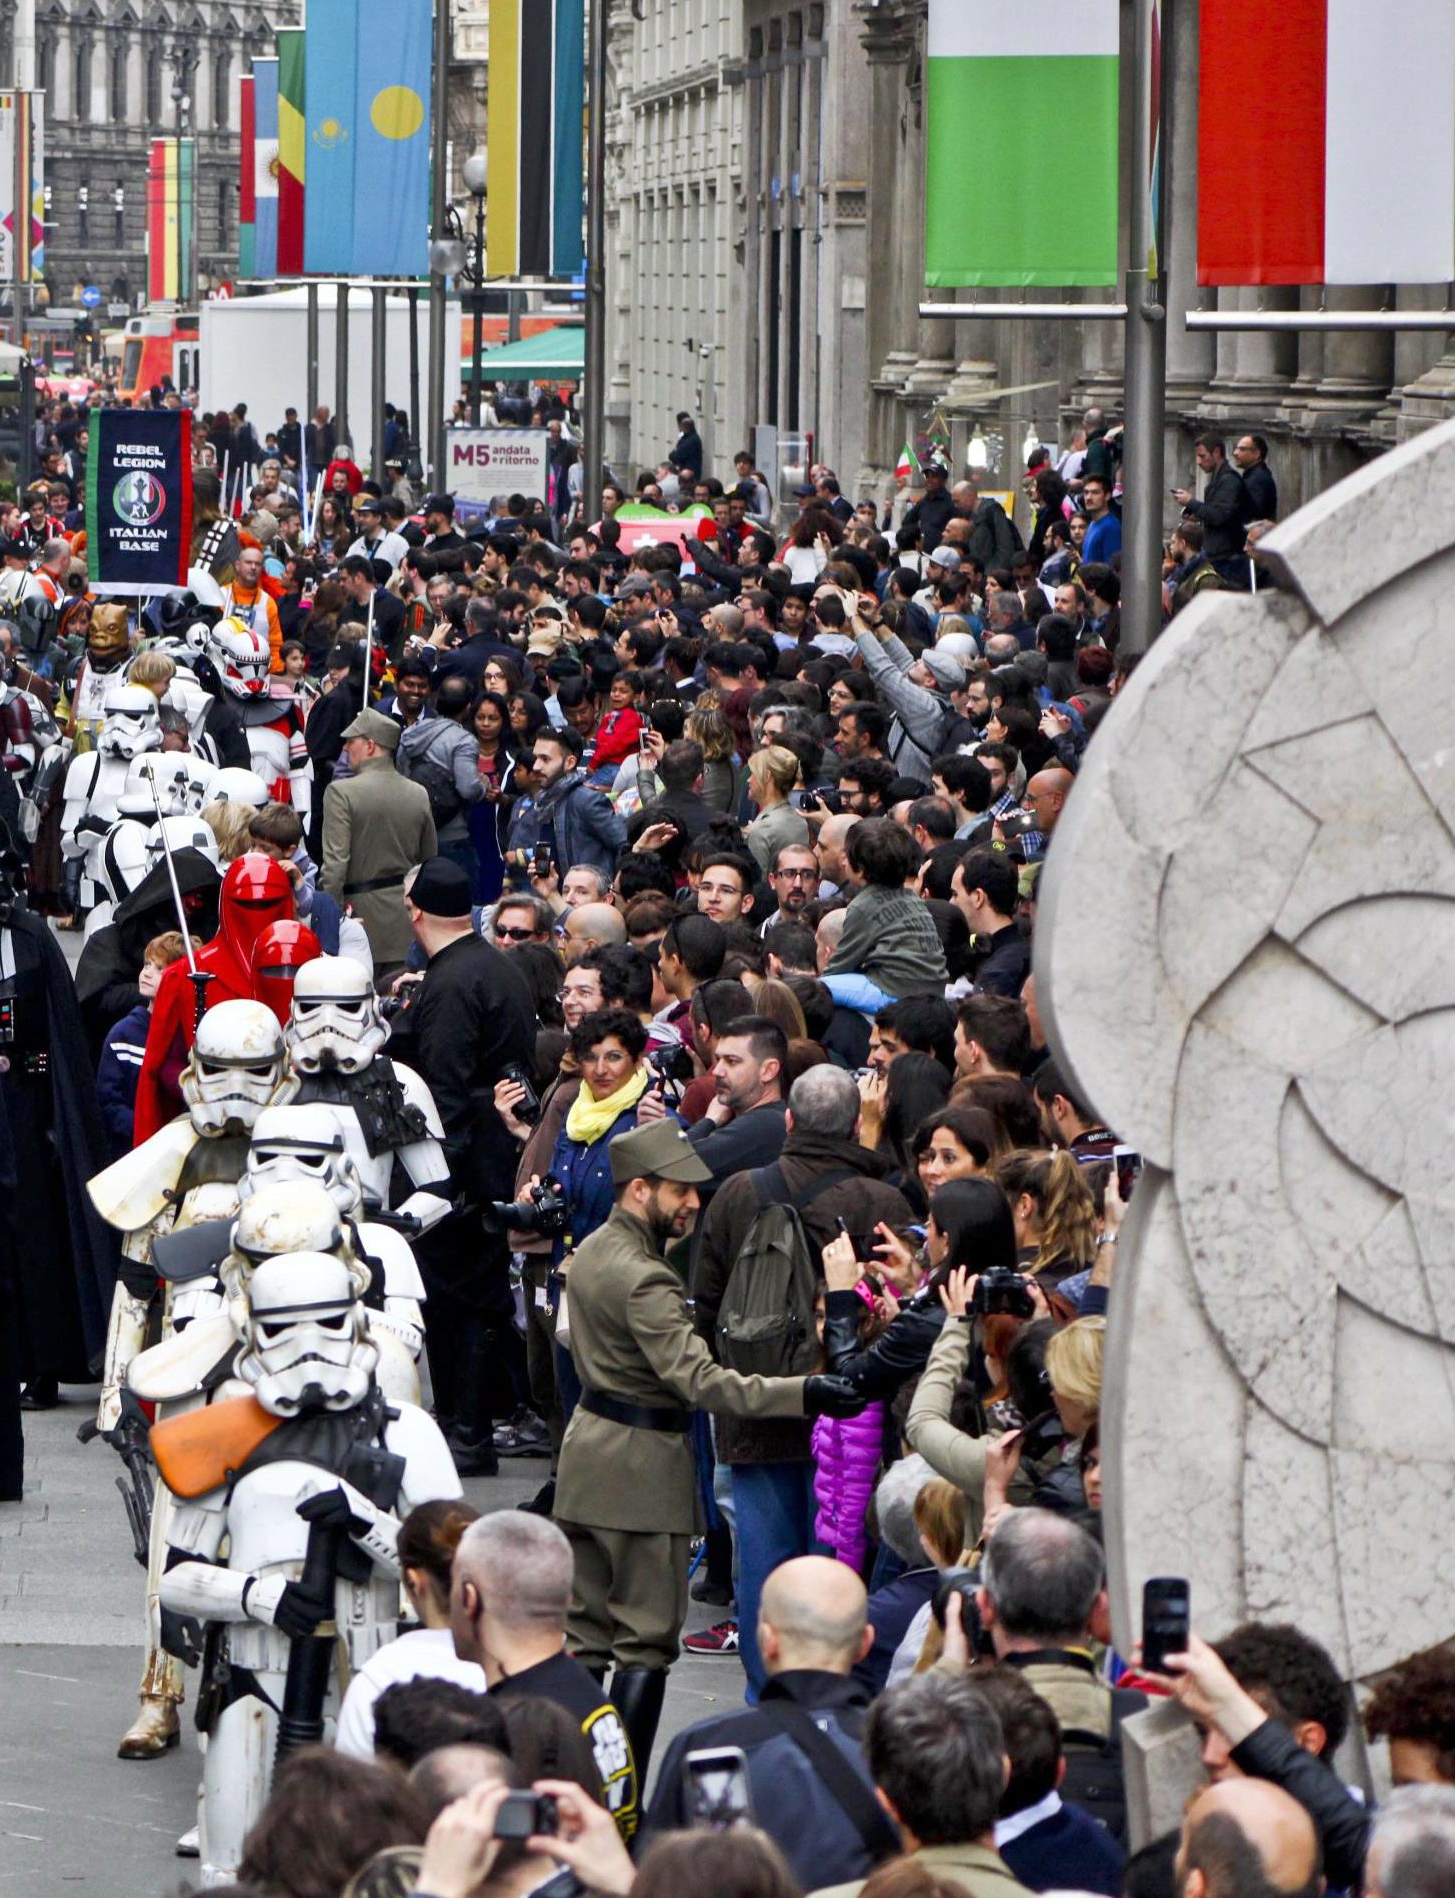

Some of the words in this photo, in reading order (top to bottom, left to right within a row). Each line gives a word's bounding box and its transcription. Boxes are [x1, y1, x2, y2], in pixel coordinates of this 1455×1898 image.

[116, 444, 163, 456] REBEL
[453, 444, 490, 466] M5
[492, 445, 530, 455] andata
[113, 457, 166, 469] LEGION
[499, 454, 539, 465] ritorno
[109, 528, 167, 539] ITALIAN
[119, 541, 159, 552] BASE
